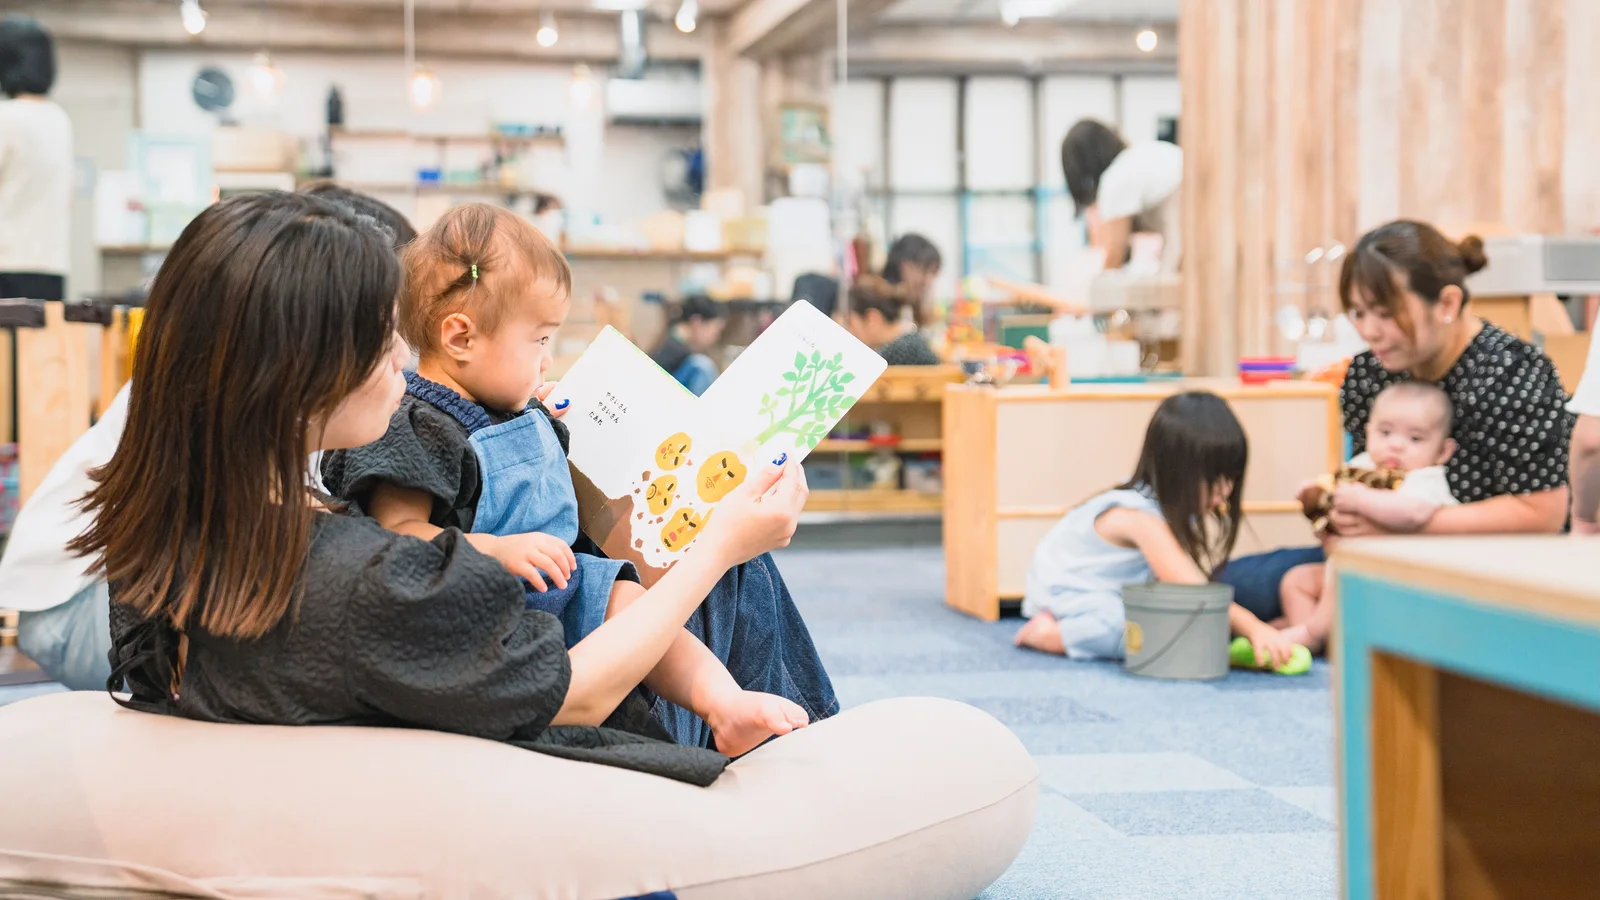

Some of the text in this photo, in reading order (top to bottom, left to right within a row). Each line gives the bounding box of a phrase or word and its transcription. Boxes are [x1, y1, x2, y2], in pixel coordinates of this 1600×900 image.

[598, 401, 619, 424] やさいさん
[606, 391, 627, 413] やさいさん
